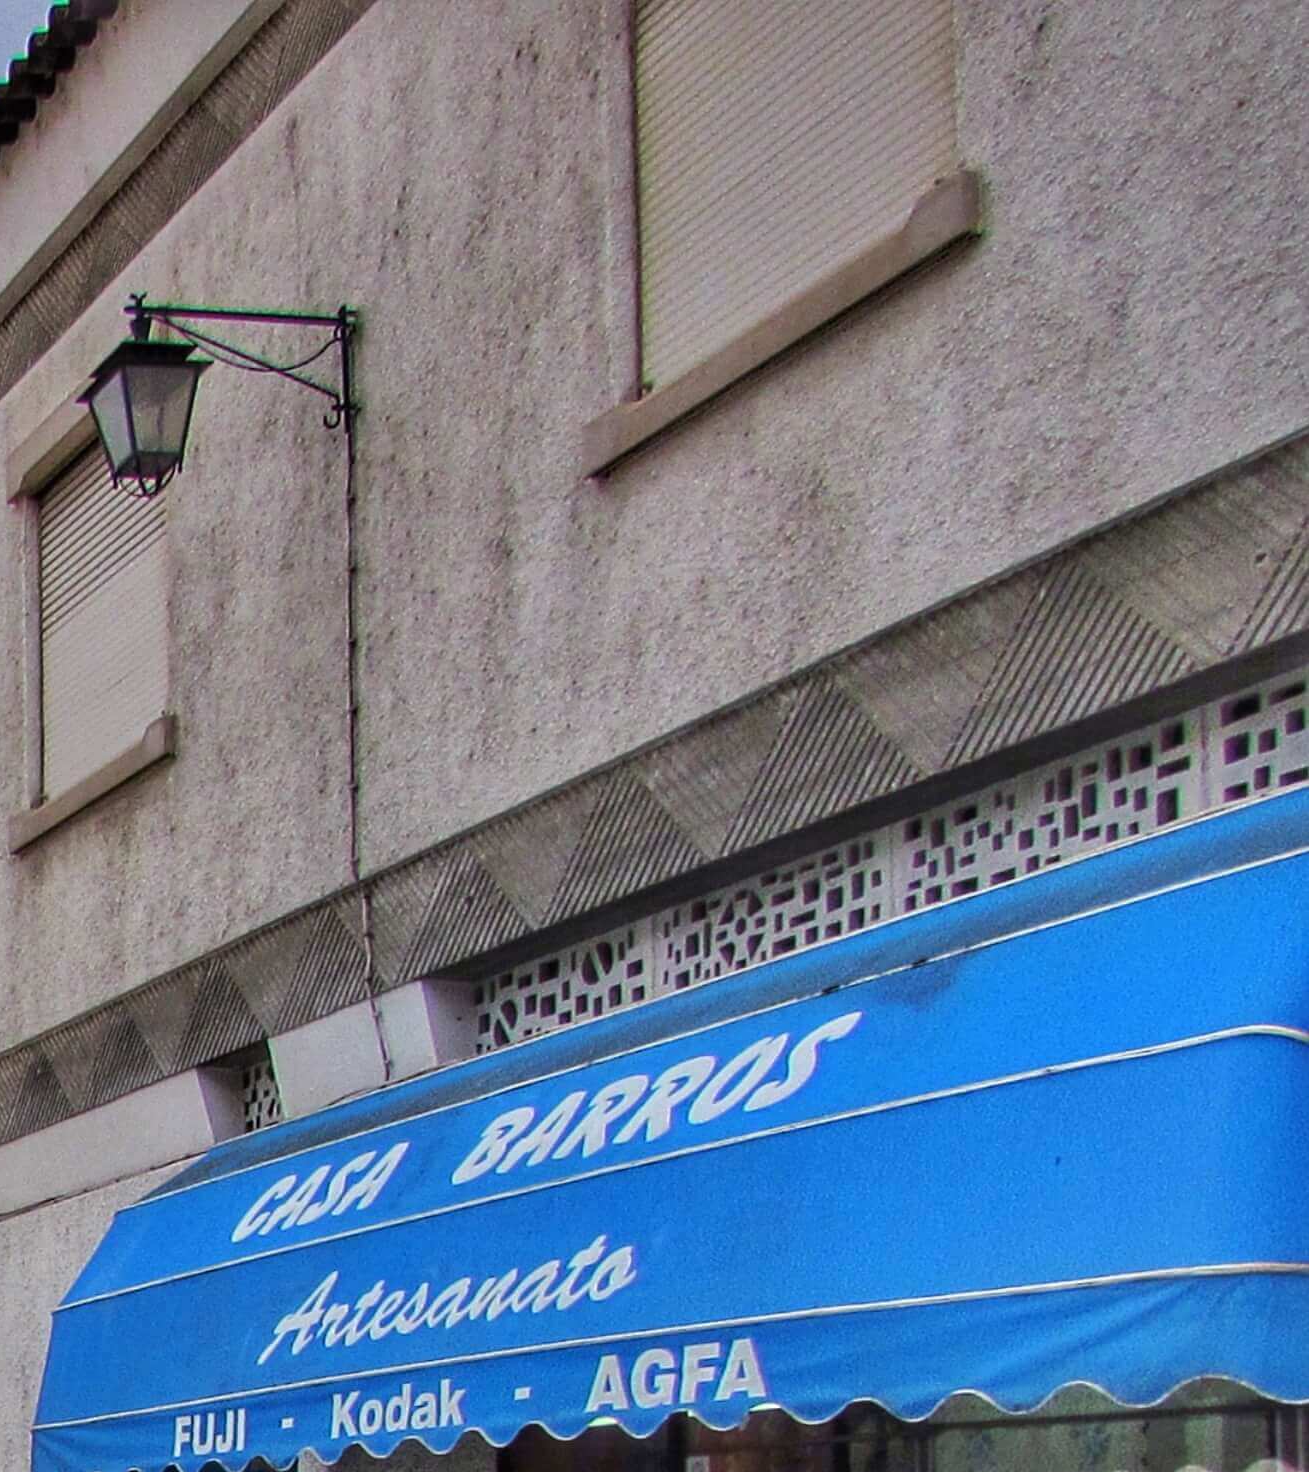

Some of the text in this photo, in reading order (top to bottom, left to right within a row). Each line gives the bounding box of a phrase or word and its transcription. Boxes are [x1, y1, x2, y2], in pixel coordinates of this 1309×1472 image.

[231, 1010, 864, 1243] CASA BARROS
[257, 1234, 638, 1366] Artesanato
[173, 1408, 246, 1457] FUJI
[331, 1378, 466, 1439] Kodak
[585, 1337, 768, 1413] AGFA
